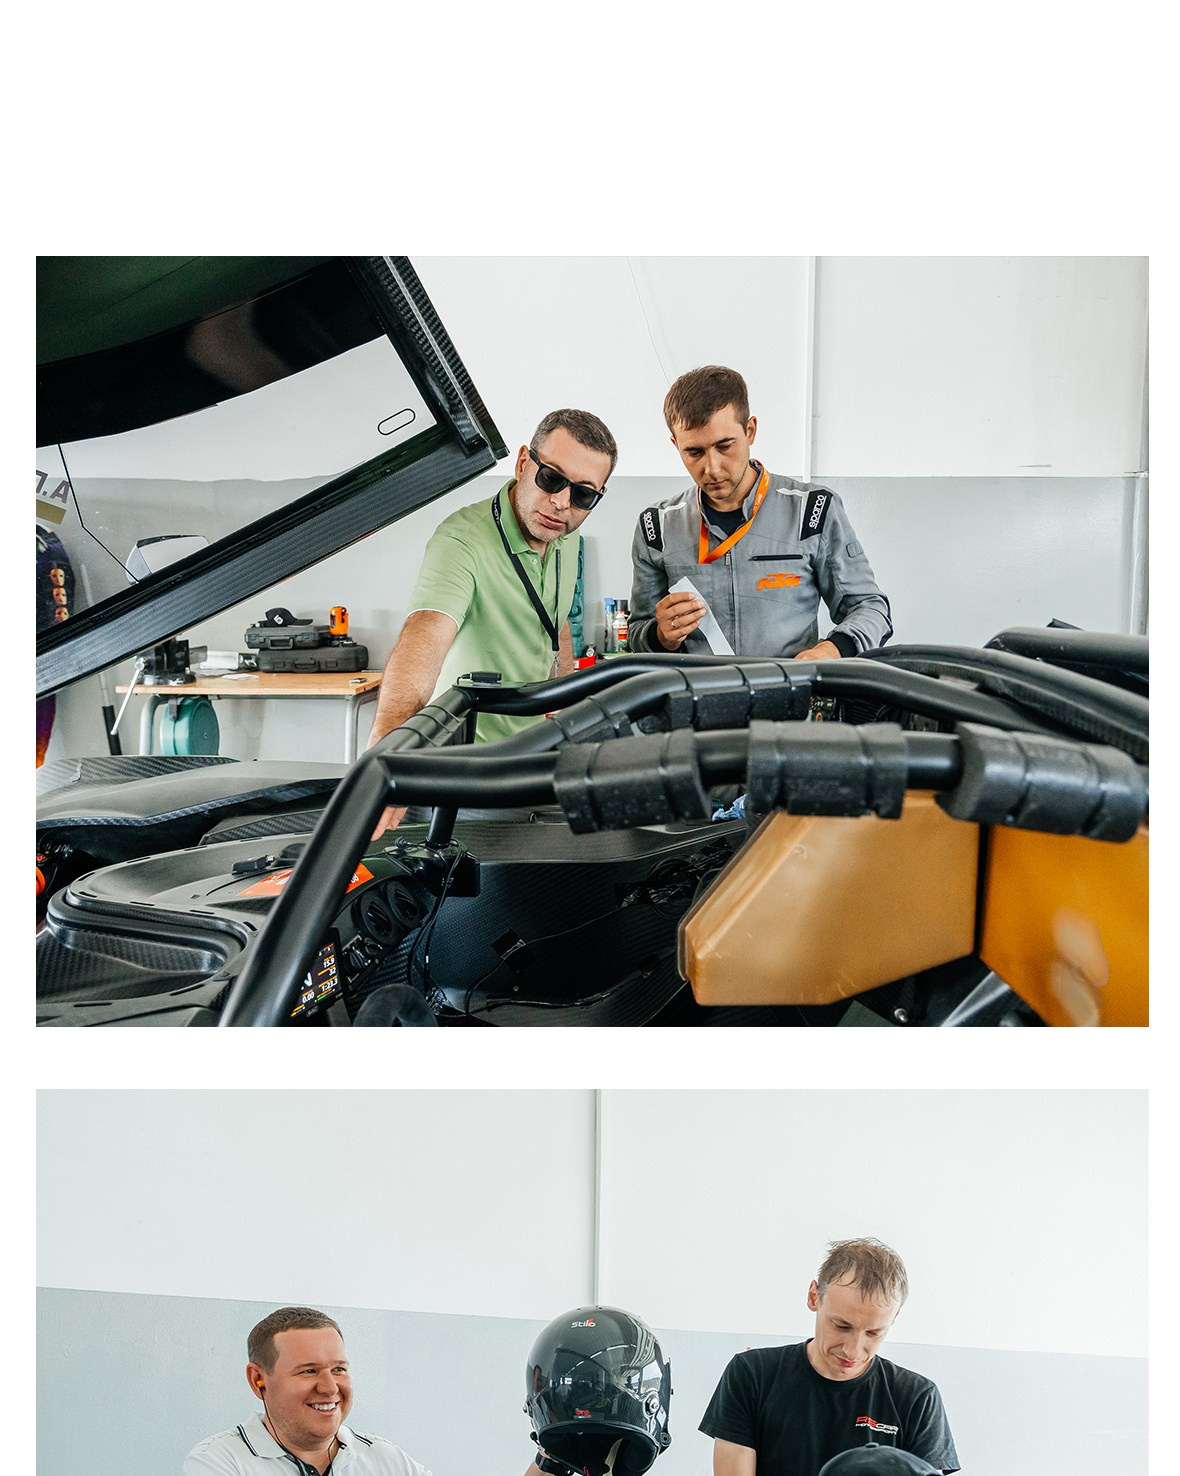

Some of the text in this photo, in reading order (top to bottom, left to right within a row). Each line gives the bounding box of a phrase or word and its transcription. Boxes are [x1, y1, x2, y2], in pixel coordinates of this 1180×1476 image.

[808, 494, 827, 529] sparco
[643, 511, 657, 542] sparco
[755, 572, 801, 590] KTM
[856, 1416, 899, 1432] RSCAR
